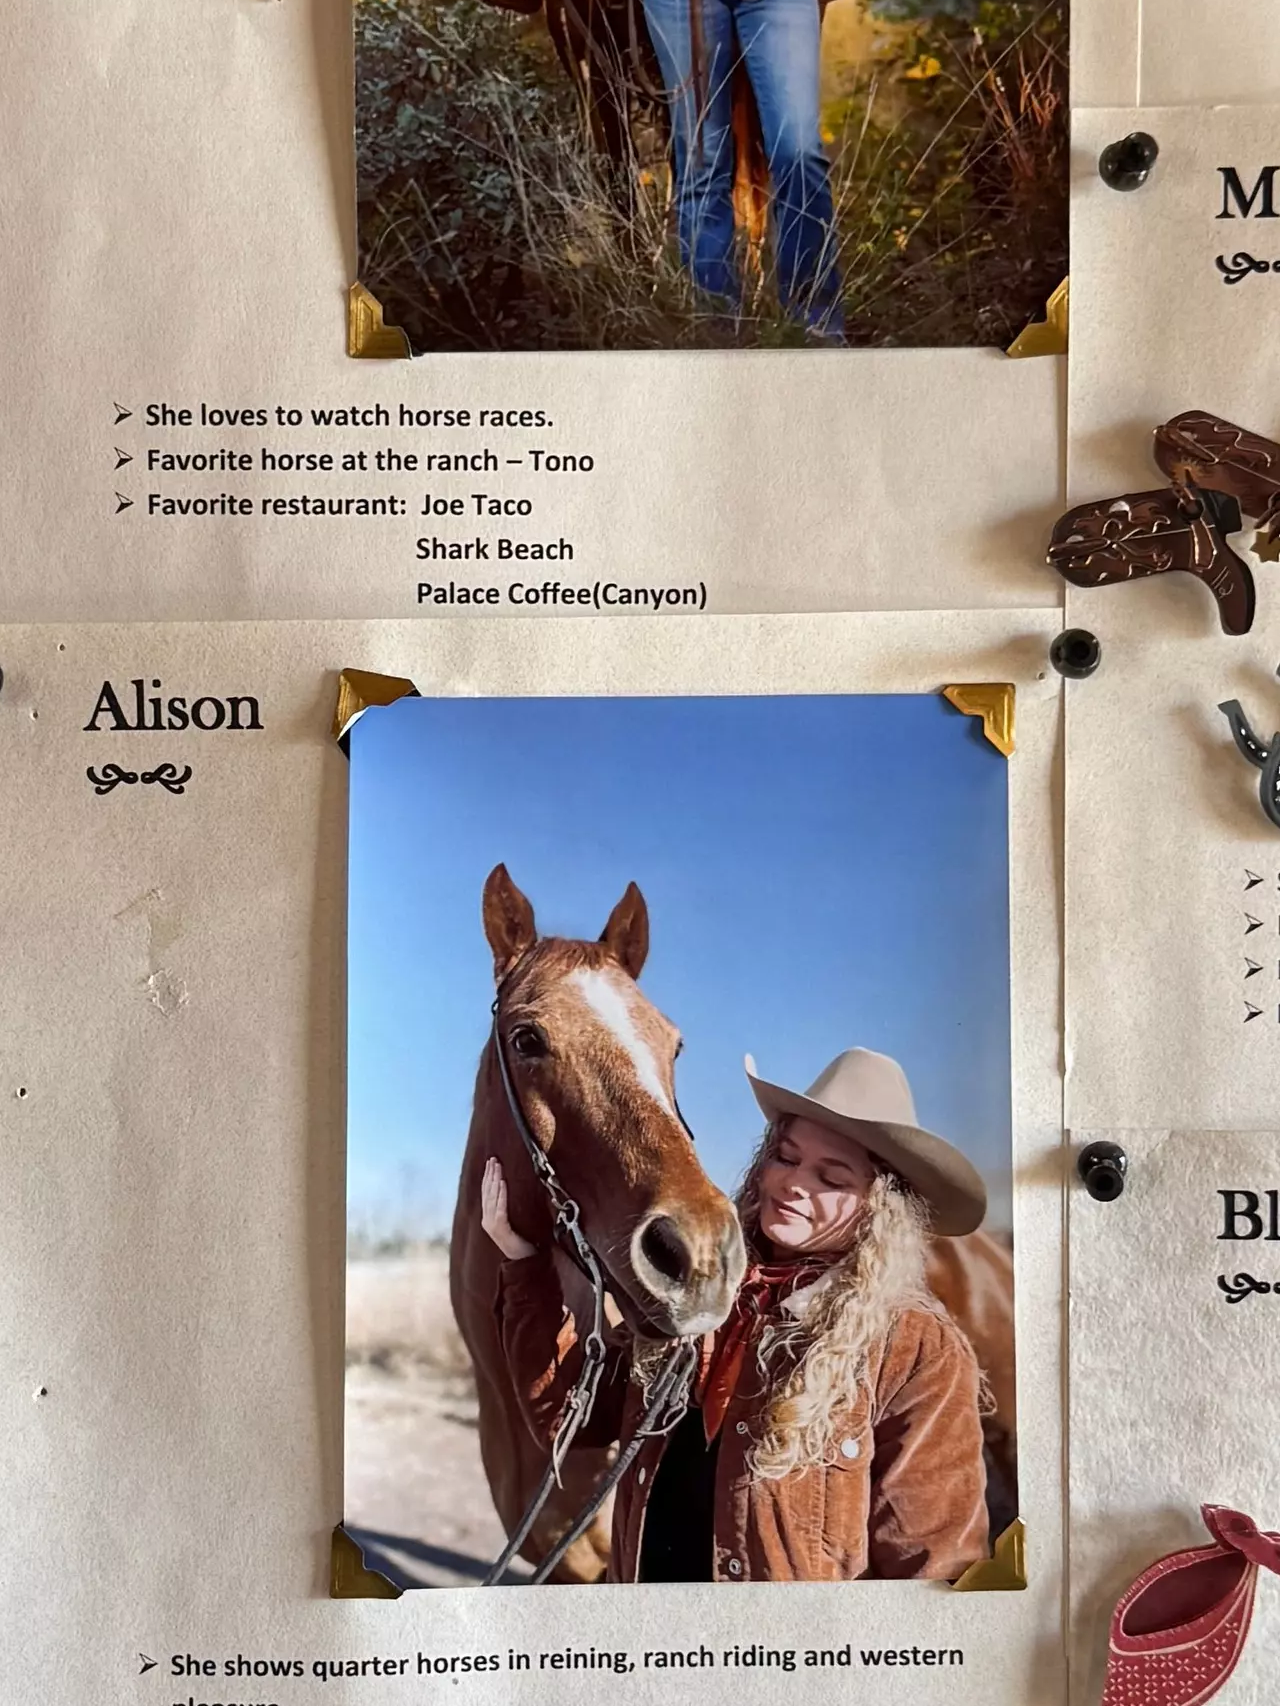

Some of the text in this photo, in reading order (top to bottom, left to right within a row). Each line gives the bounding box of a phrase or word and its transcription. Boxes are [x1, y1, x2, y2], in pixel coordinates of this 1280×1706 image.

[145, 402, 554, 428] She loves to watch horse races.
[148, 492, 533, 516] Favorite restaurant: Joe Taco
[415, 536, 574, 561] Shark Beach
[417, 581, 707, 611] Palace Coffee(Canyon)
[82, 680, 264, 732] Alison
[170, 1643, 964, 1683] She shows quarter horses in reining, ranch riding and western
